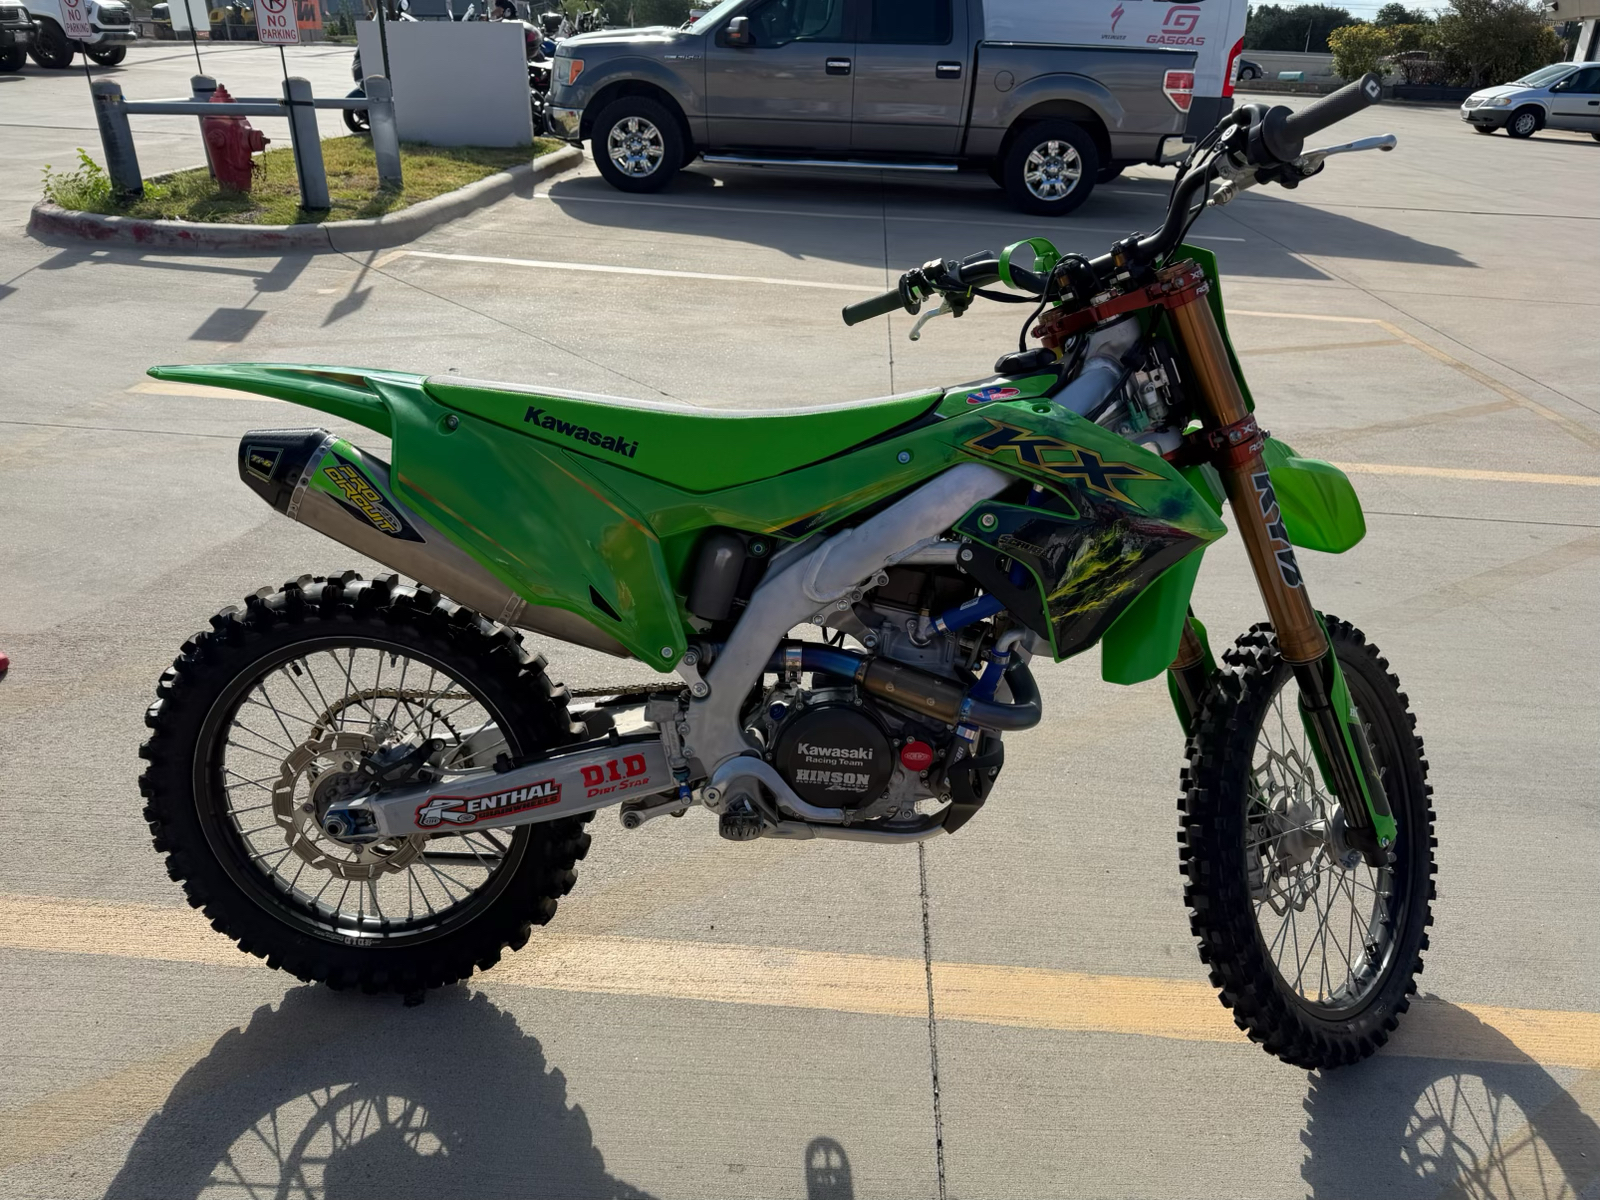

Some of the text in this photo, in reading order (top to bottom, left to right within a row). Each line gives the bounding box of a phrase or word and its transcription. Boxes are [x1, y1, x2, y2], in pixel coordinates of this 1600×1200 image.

[67, 9, 81, 21] NO
[267, 15, 287, 27] NO
[66, 22, 89, 33] PARKING
[261, 28, 296, 40] PARKING
[1146, 34, 1206, 46] GASGAS
[523, 406, 640, 459] Kawasaki
[963, 415, 1173, 513] KX
[338, 465, 382, 502] PRO
[323, 467, 397, 532] CIRCUIT
[797, 742, 873, 760] Kawasaki
[805, 755, 864, 767] Racing Team
[795, 769, 871, 785] HINSON
